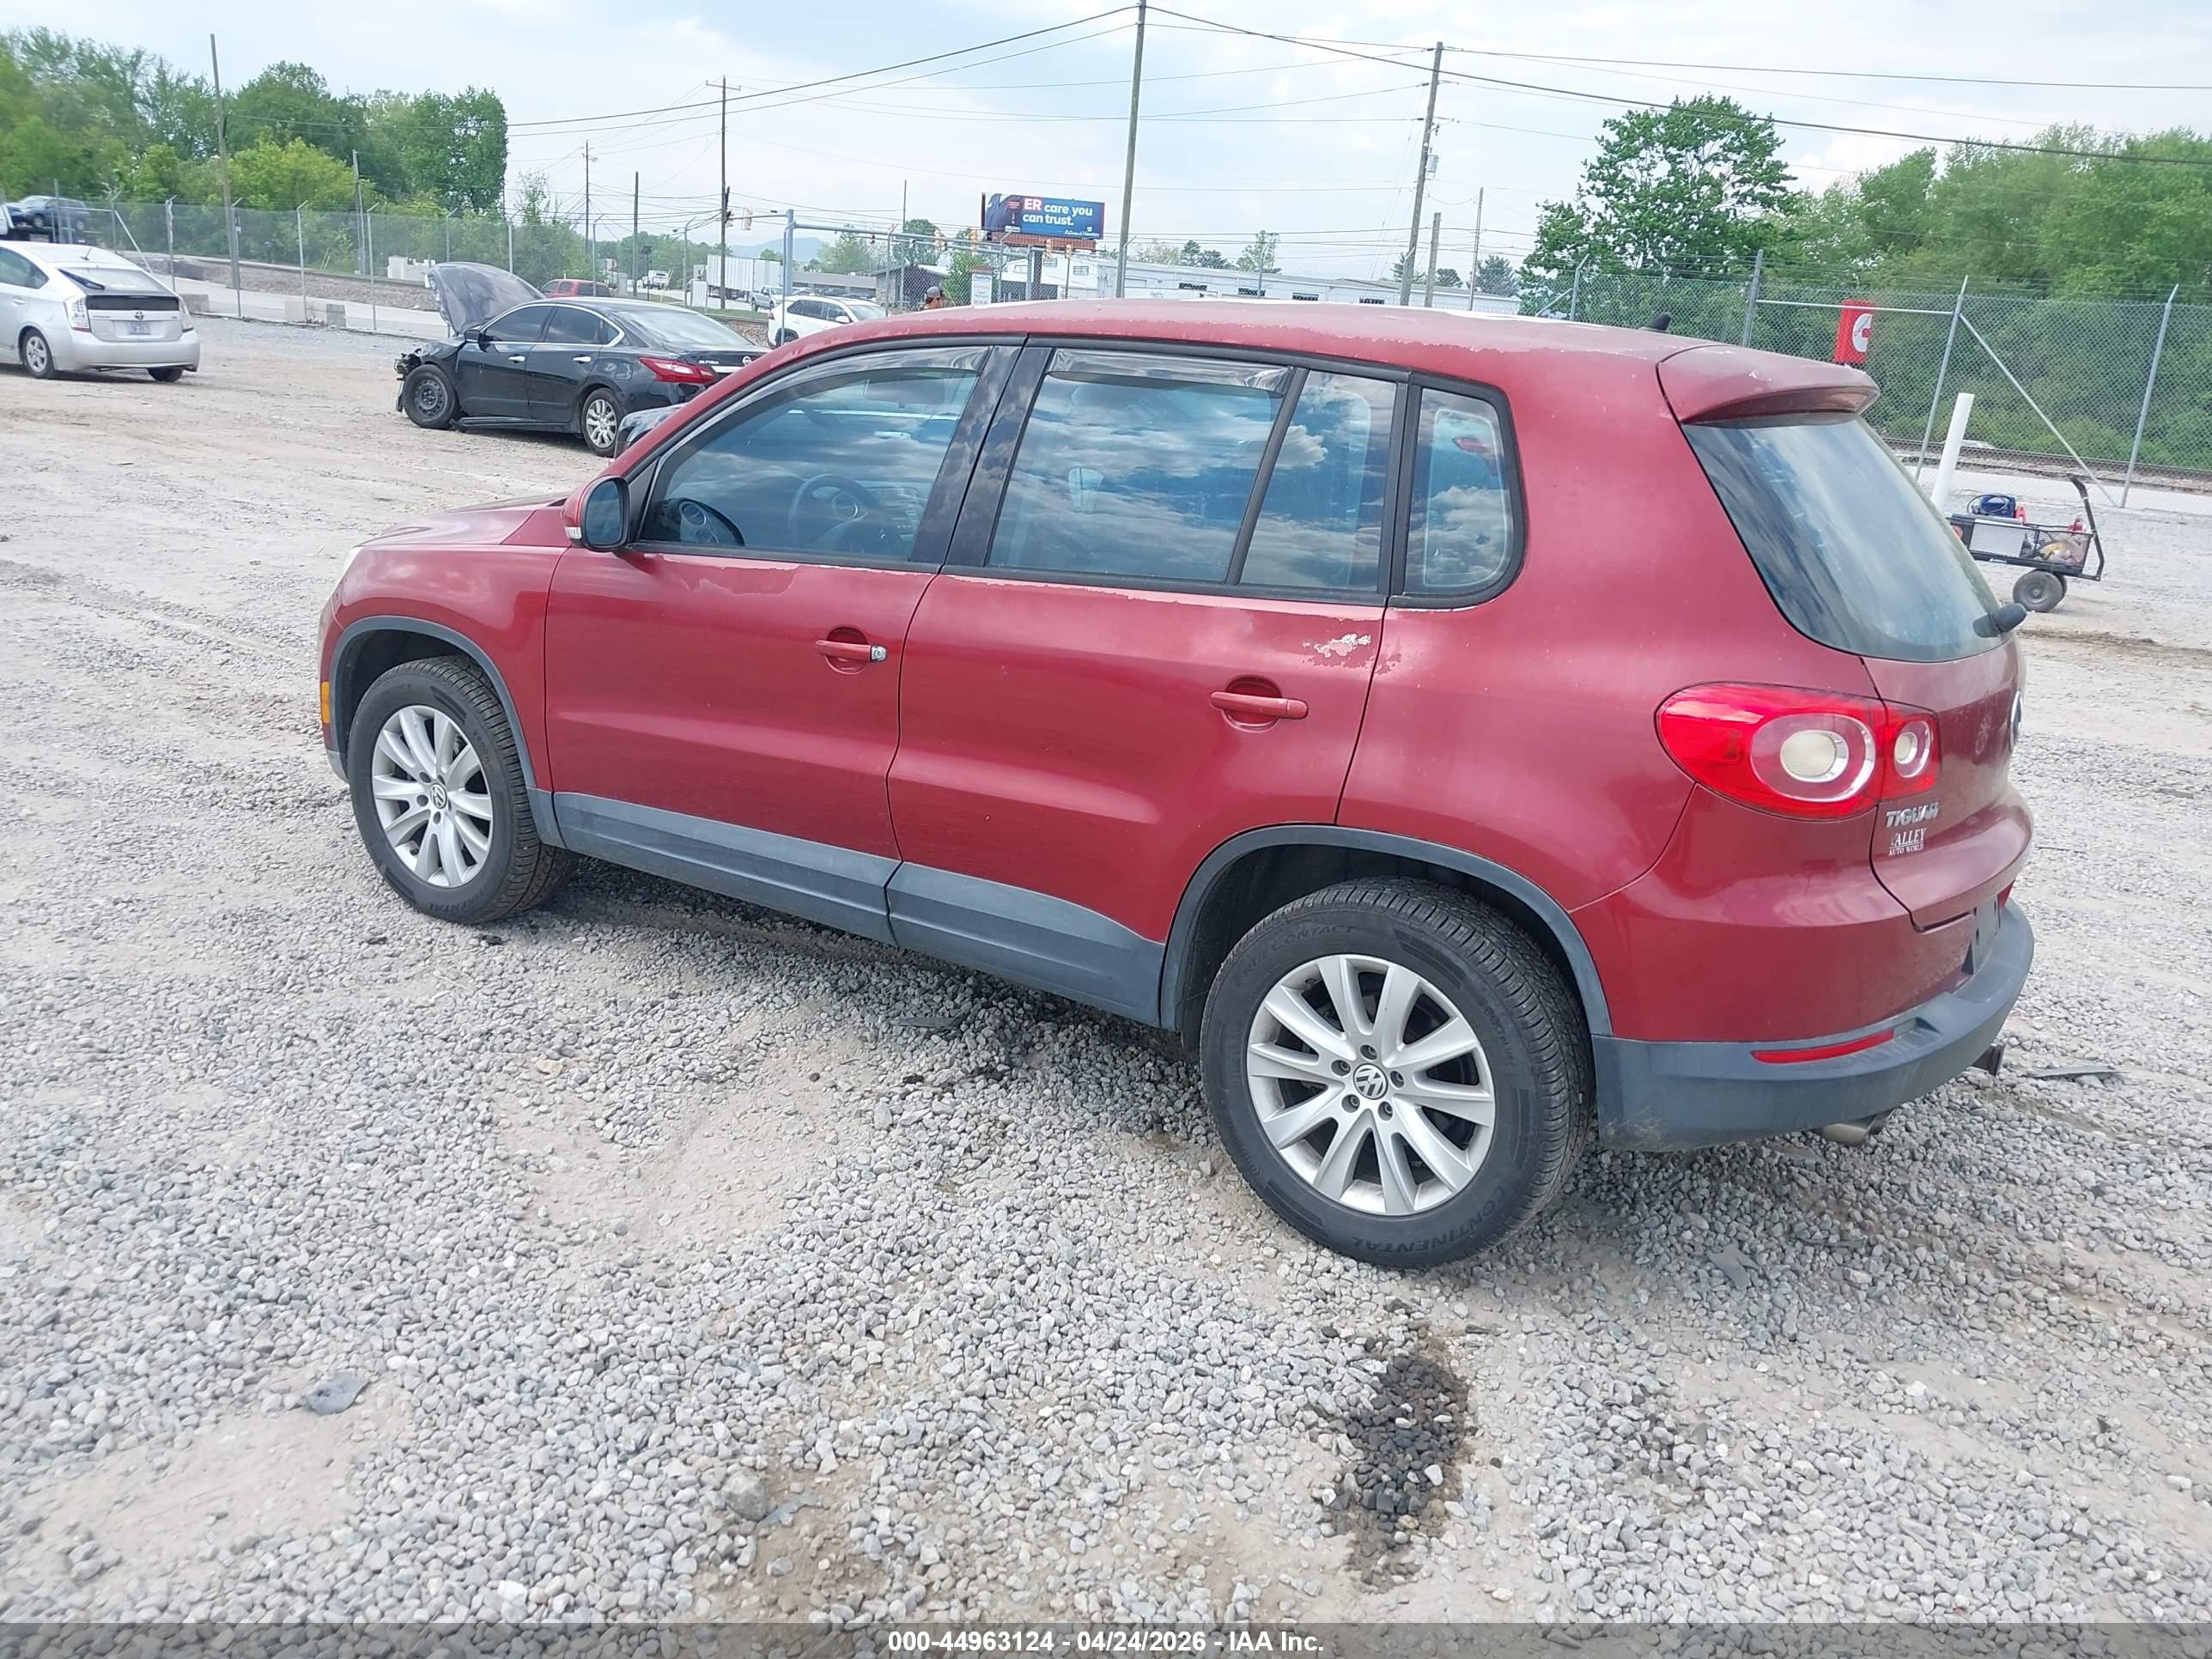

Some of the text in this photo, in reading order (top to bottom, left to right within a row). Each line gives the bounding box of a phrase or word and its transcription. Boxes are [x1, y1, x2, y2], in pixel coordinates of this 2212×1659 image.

[1024, 198, 1092, 217] ER care you
[1023, 213, 1074, 227] can trust.
[1886, 803, 1939, 828] TIGUAN
[1888, 842, 1924, 857] AUTO WORLD
